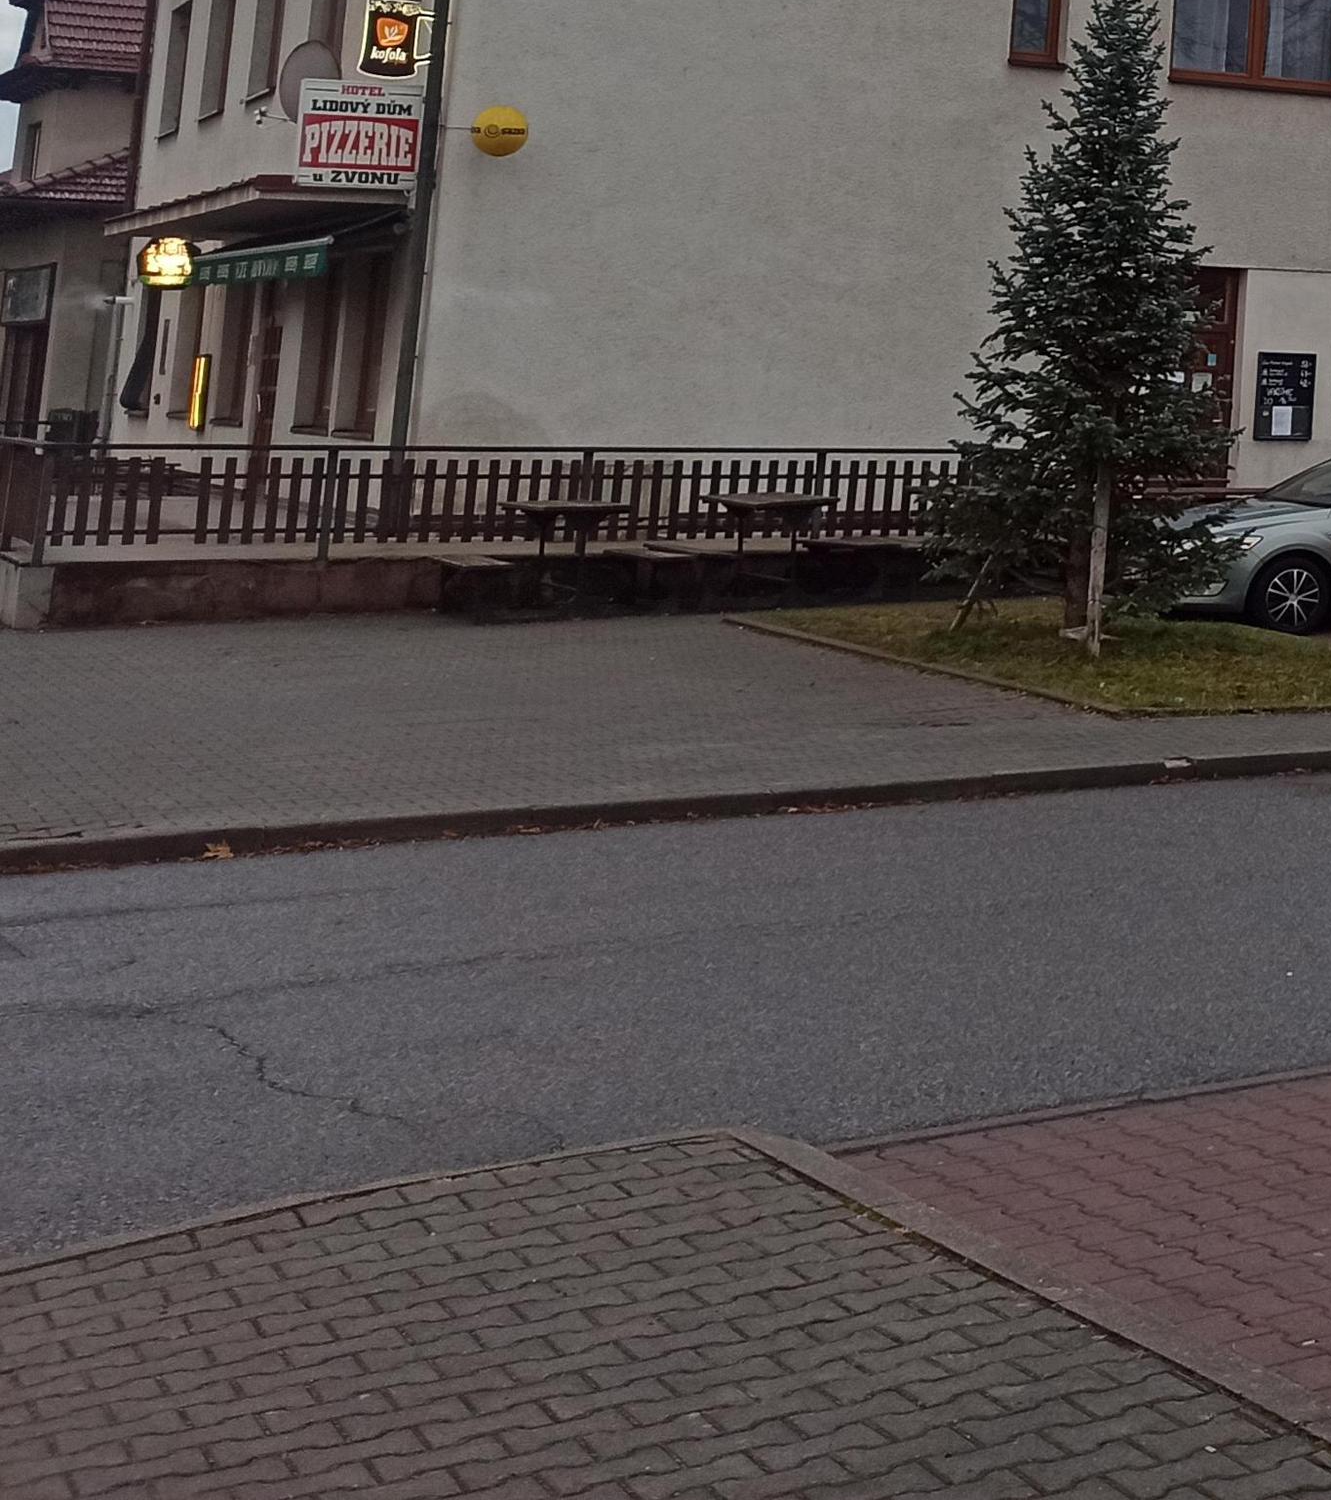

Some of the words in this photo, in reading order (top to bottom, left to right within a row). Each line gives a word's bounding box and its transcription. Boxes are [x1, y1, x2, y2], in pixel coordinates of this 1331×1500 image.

[370, 46, 408, 64] kofola
[341, 85, 386, 97] HOTEL
[311, 99, 371, 114] LIDOVÝ
[376, 100, 412, 116] DŮM
[303, 120, 413, 166] PIZZERIE
[330, 170, 400, 185] ZVONU
